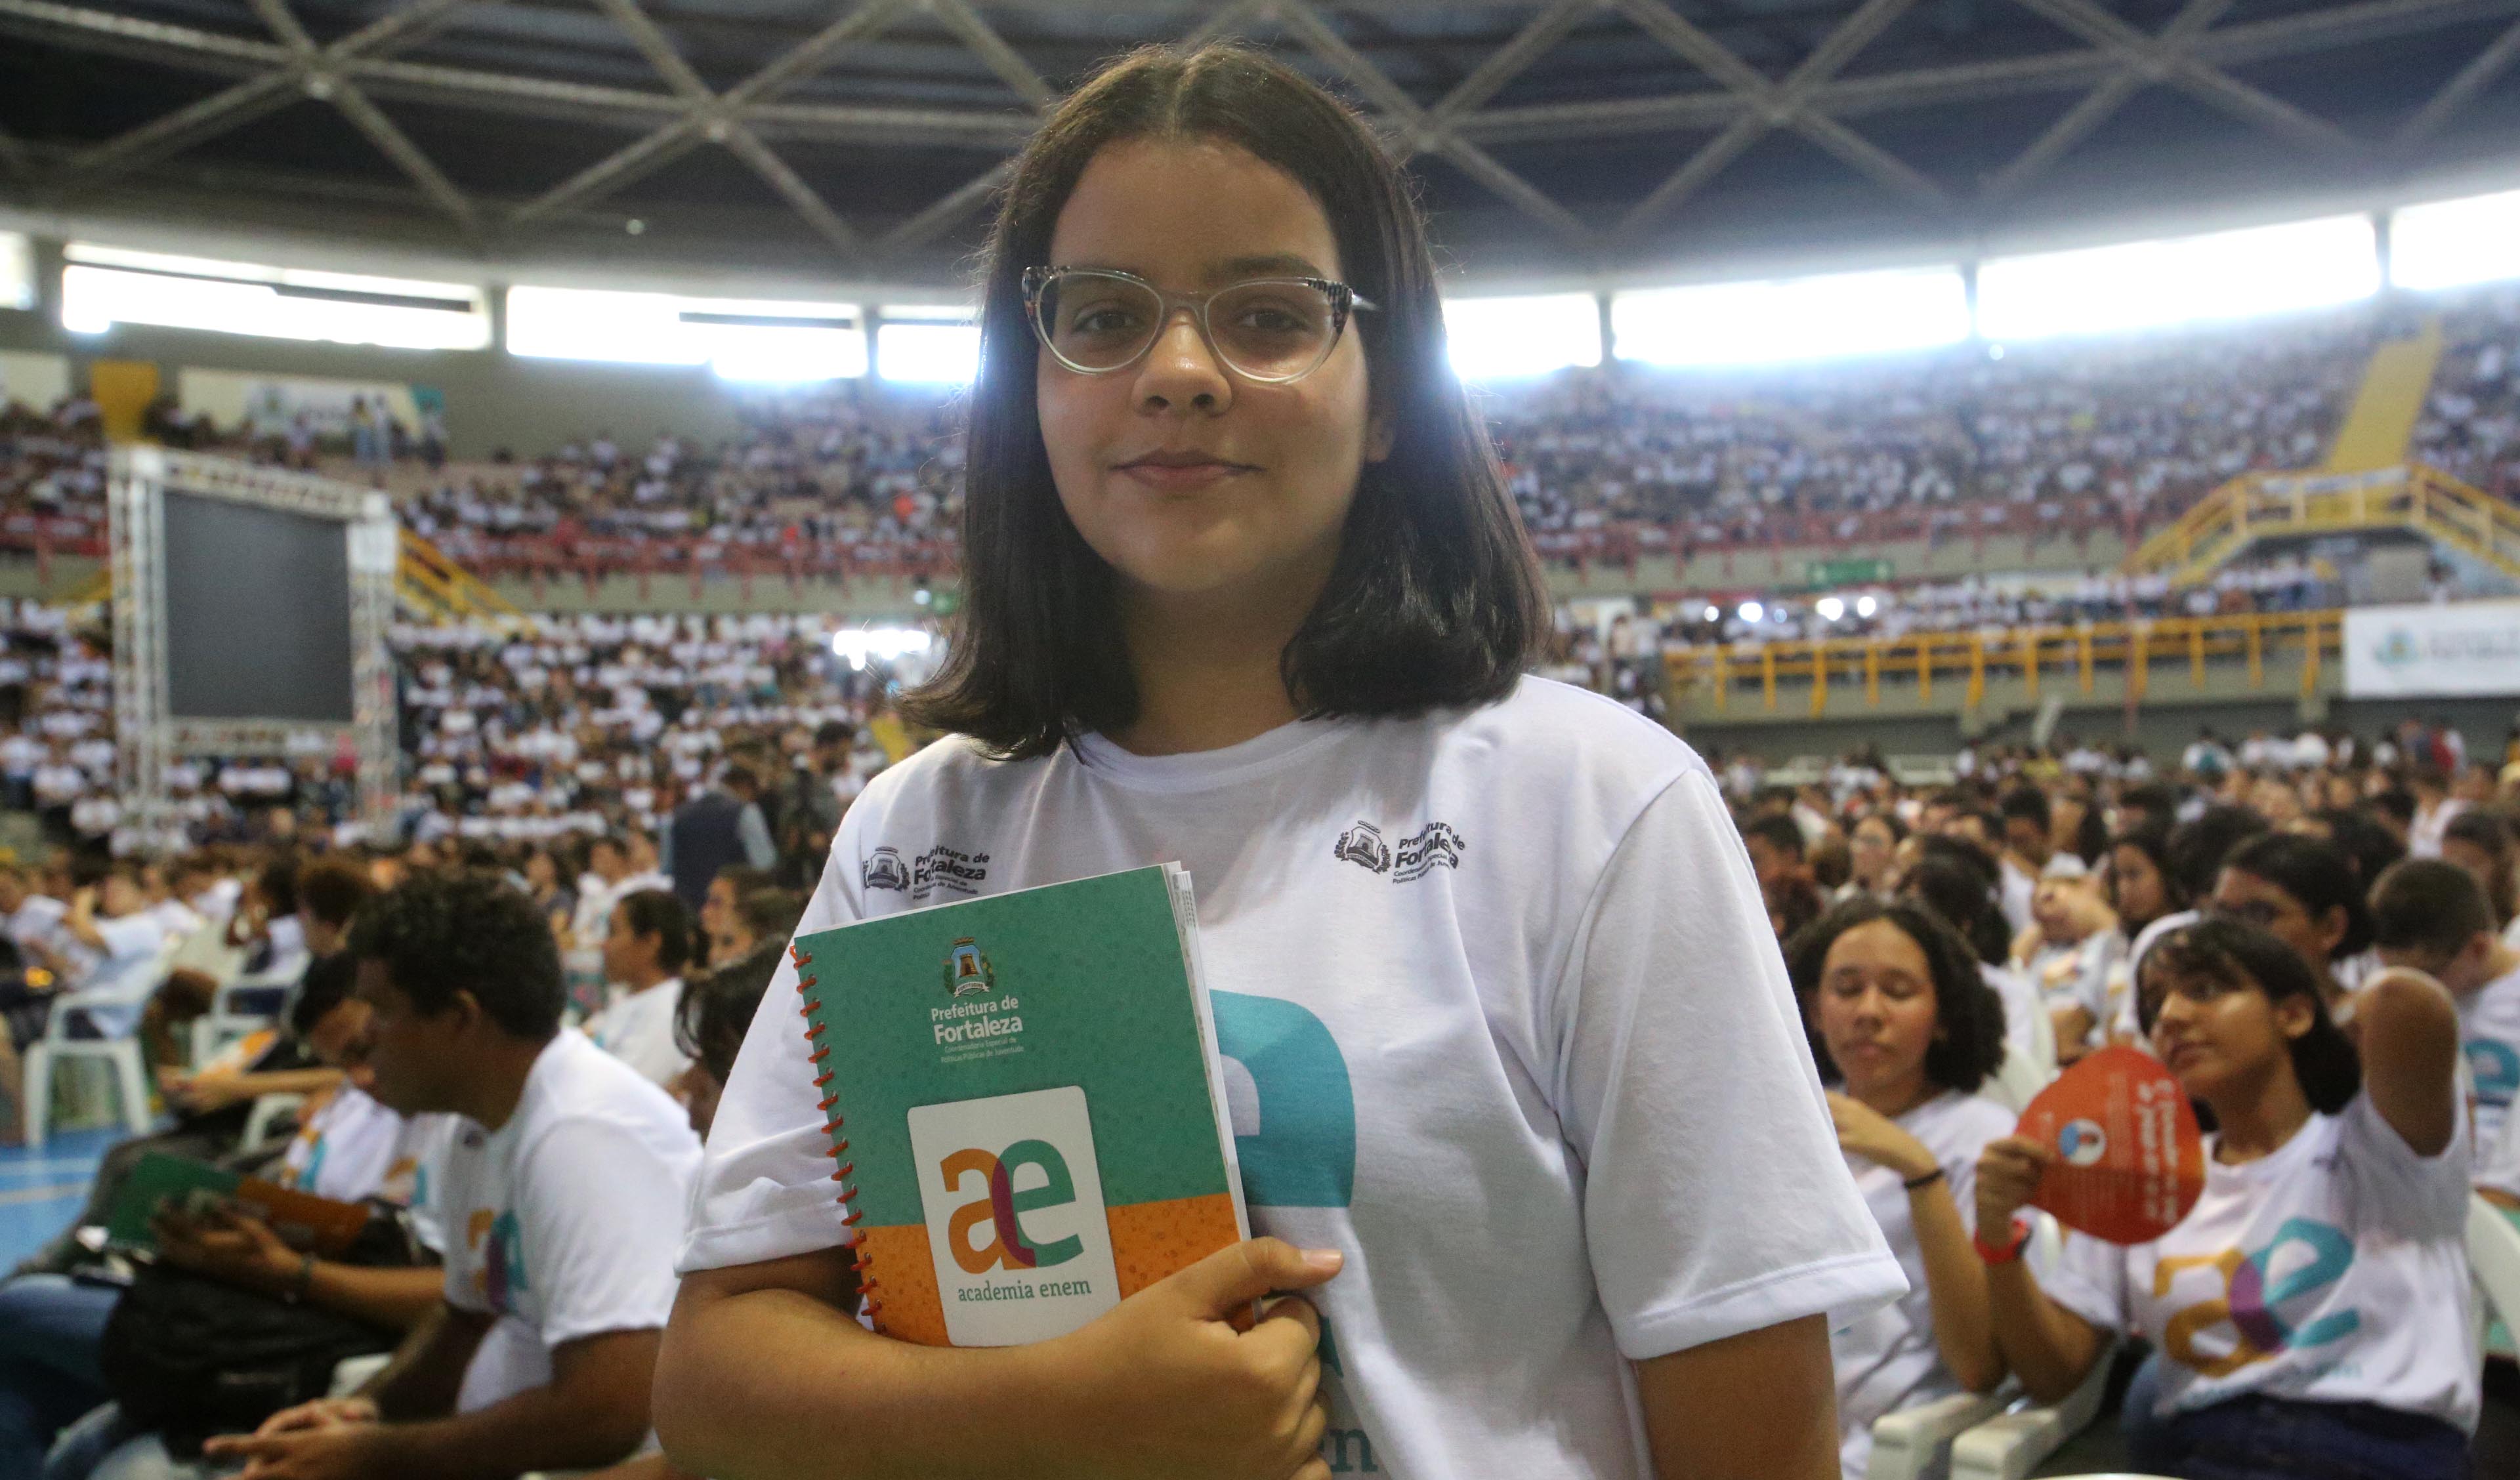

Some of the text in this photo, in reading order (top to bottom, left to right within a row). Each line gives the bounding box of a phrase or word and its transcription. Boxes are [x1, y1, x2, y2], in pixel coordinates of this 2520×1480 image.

[915, 845, 990, 867] Preitura de
[1452, 834, 1465, 851] de
[914, 858, 986, 885] Fotaleza
[931, 995, 1018, 1022] Prefeitura de
[934, 1016, 1023, 1045] Fortaleza
[940, 1139, 1085, 1275] ae
[958, 1279, 1092, 1302] academia enem
